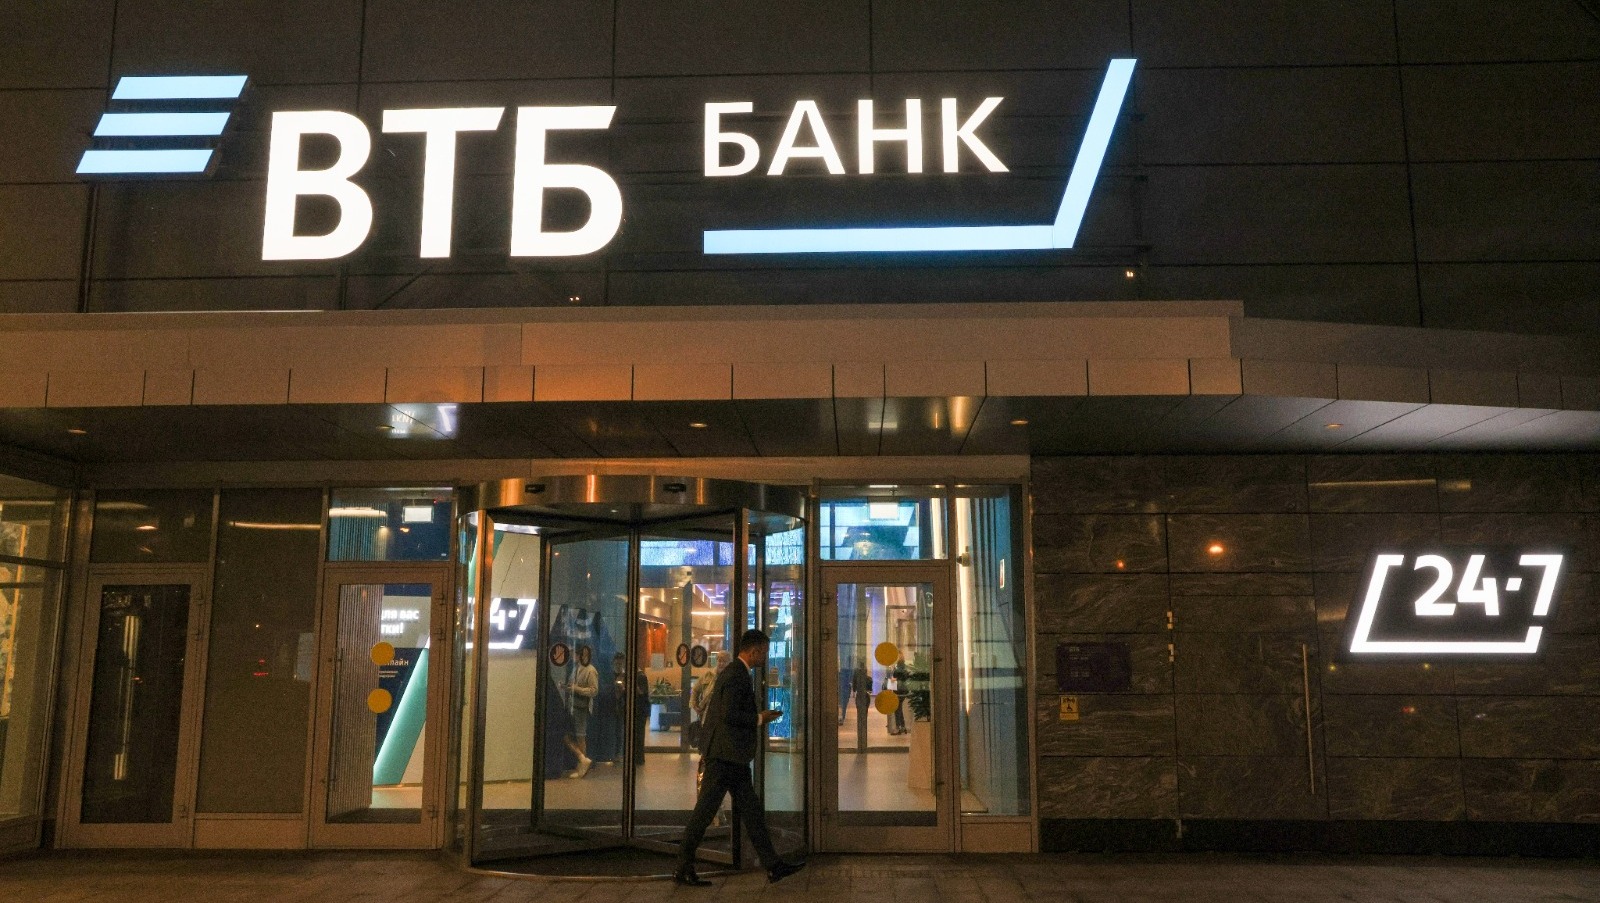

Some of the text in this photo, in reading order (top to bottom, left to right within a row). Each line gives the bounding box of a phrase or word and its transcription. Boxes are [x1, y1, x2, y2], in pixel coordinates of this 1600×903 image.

[261, 97, 1010, 261] ВТБ БАНК
[399, 609, 420, 620] вас
